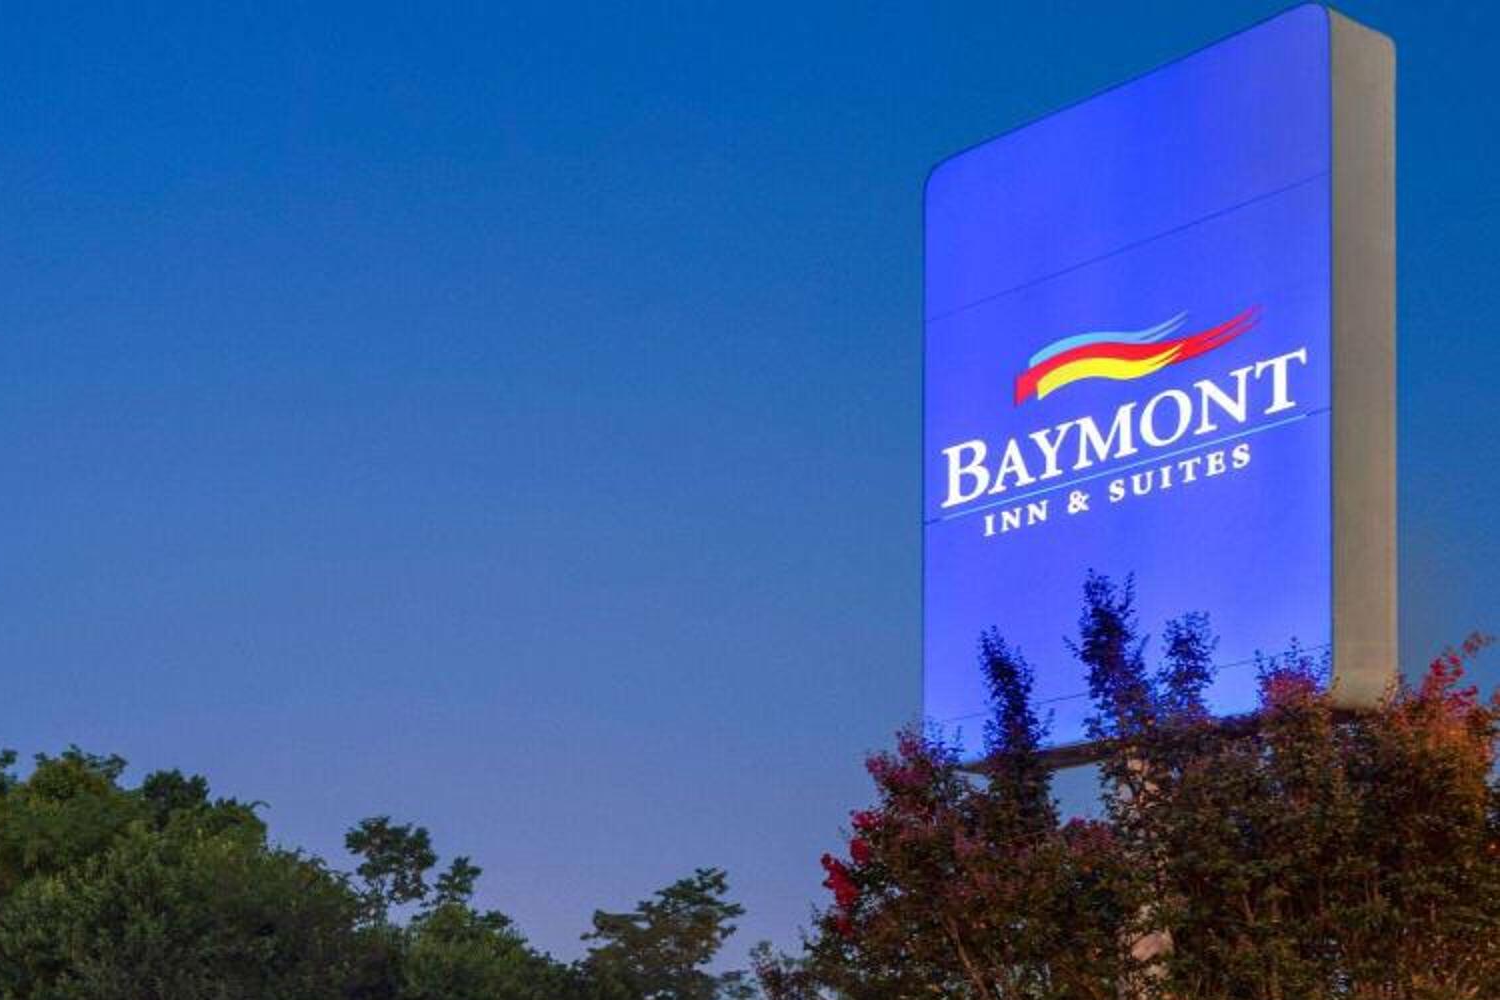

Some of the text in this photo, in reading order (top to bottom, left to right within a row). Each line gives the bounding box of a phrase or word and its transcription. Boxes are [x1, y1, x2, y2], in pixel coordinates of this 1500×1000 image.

[941, 348, 1307, 508] BAYMONT
[983, 444, 1252, 537] INN & SUITES
